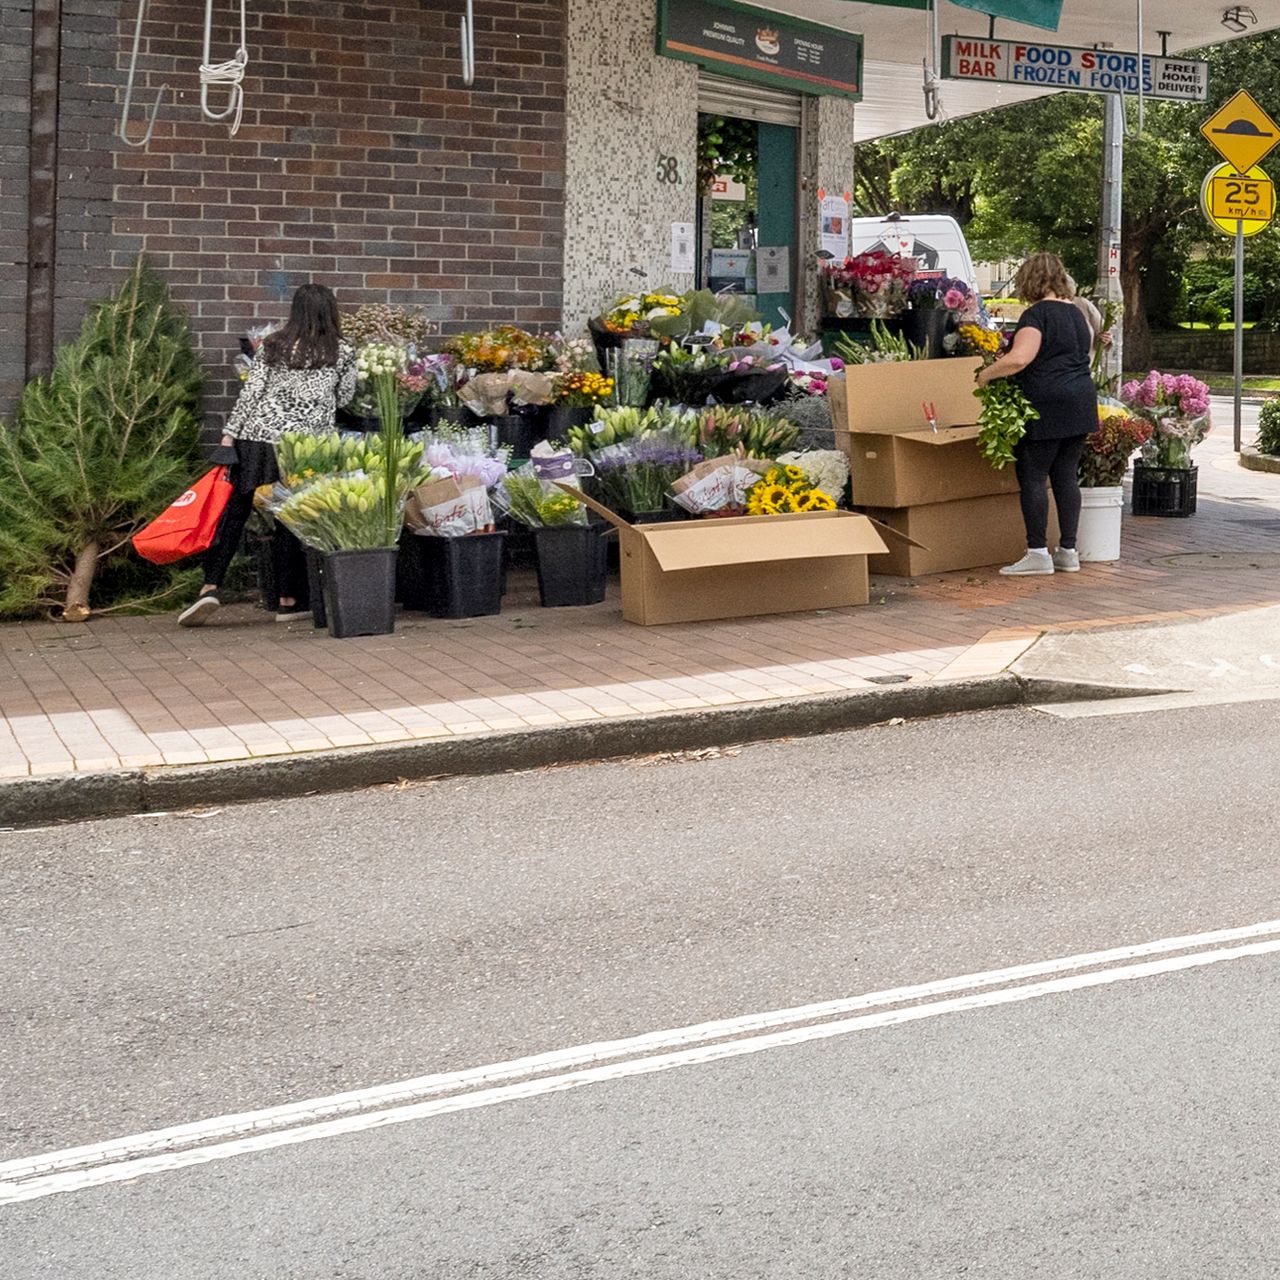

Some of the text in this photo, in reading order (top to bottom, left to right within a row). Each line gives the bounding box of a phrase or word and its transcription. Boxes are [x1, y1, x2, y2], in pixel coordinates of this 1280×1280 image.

[957, 41, 1001, 60] MILK
[1014, 45, 1151, 74] FOOD STORE
[959, 59, 996, 78] BAR
[1013, 64, 1153, 91] FROZEN FOODS
[1162, 73, 1200, 83] HOME
[1164, 63, 1199, 74] FREE
[1158, 81, 1204, 95] DELIVERY
[1225, 181, 1260, 205] 25
[1228, 207, 1257, 217] km/h
